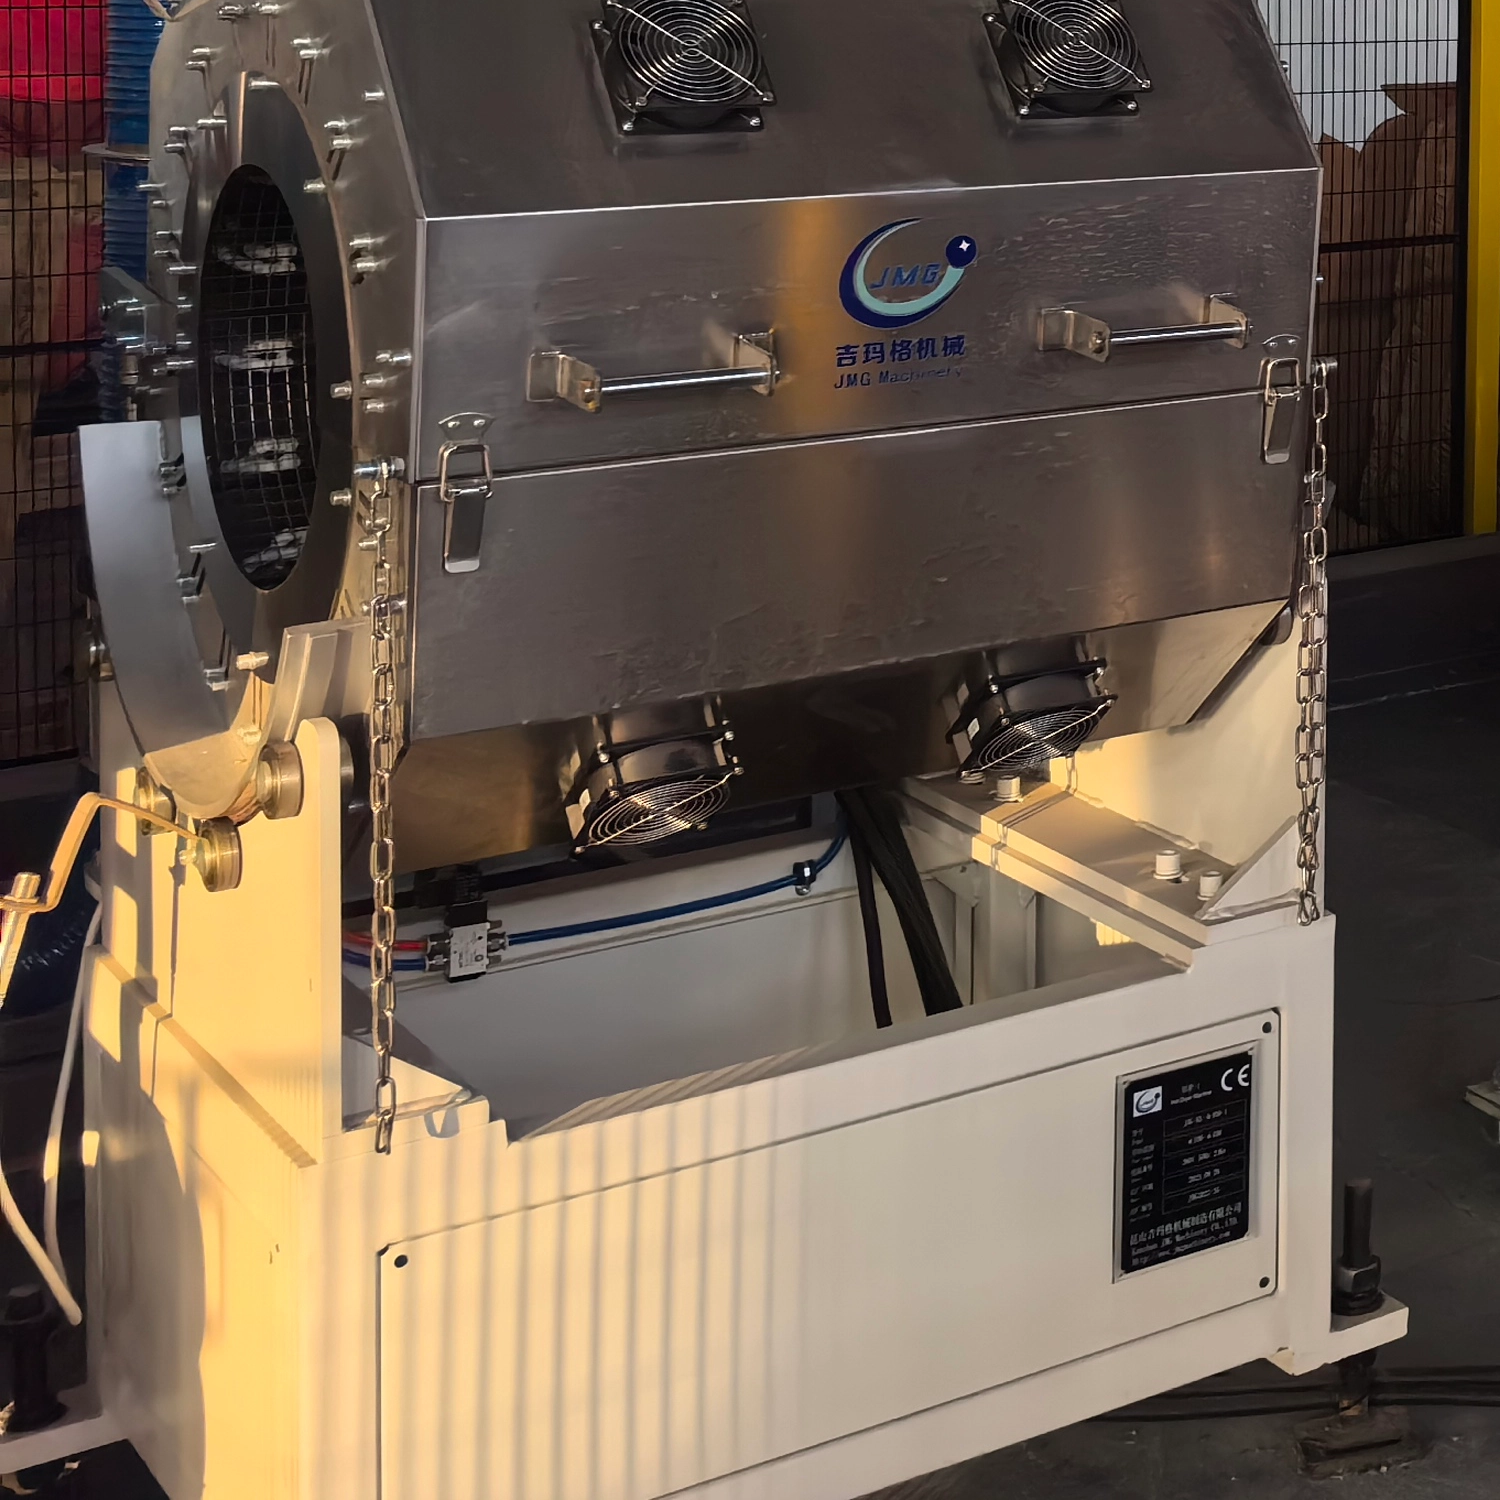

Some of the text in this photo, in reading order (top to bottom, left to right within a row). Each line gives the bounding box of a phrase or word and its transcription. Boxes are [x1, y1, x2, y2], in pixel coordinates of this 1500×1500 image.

[870, 263, 941, 289] JMG
[835, 334, 966, 368] 吉玛格机械
[834, 371, 871, 389] JMG
